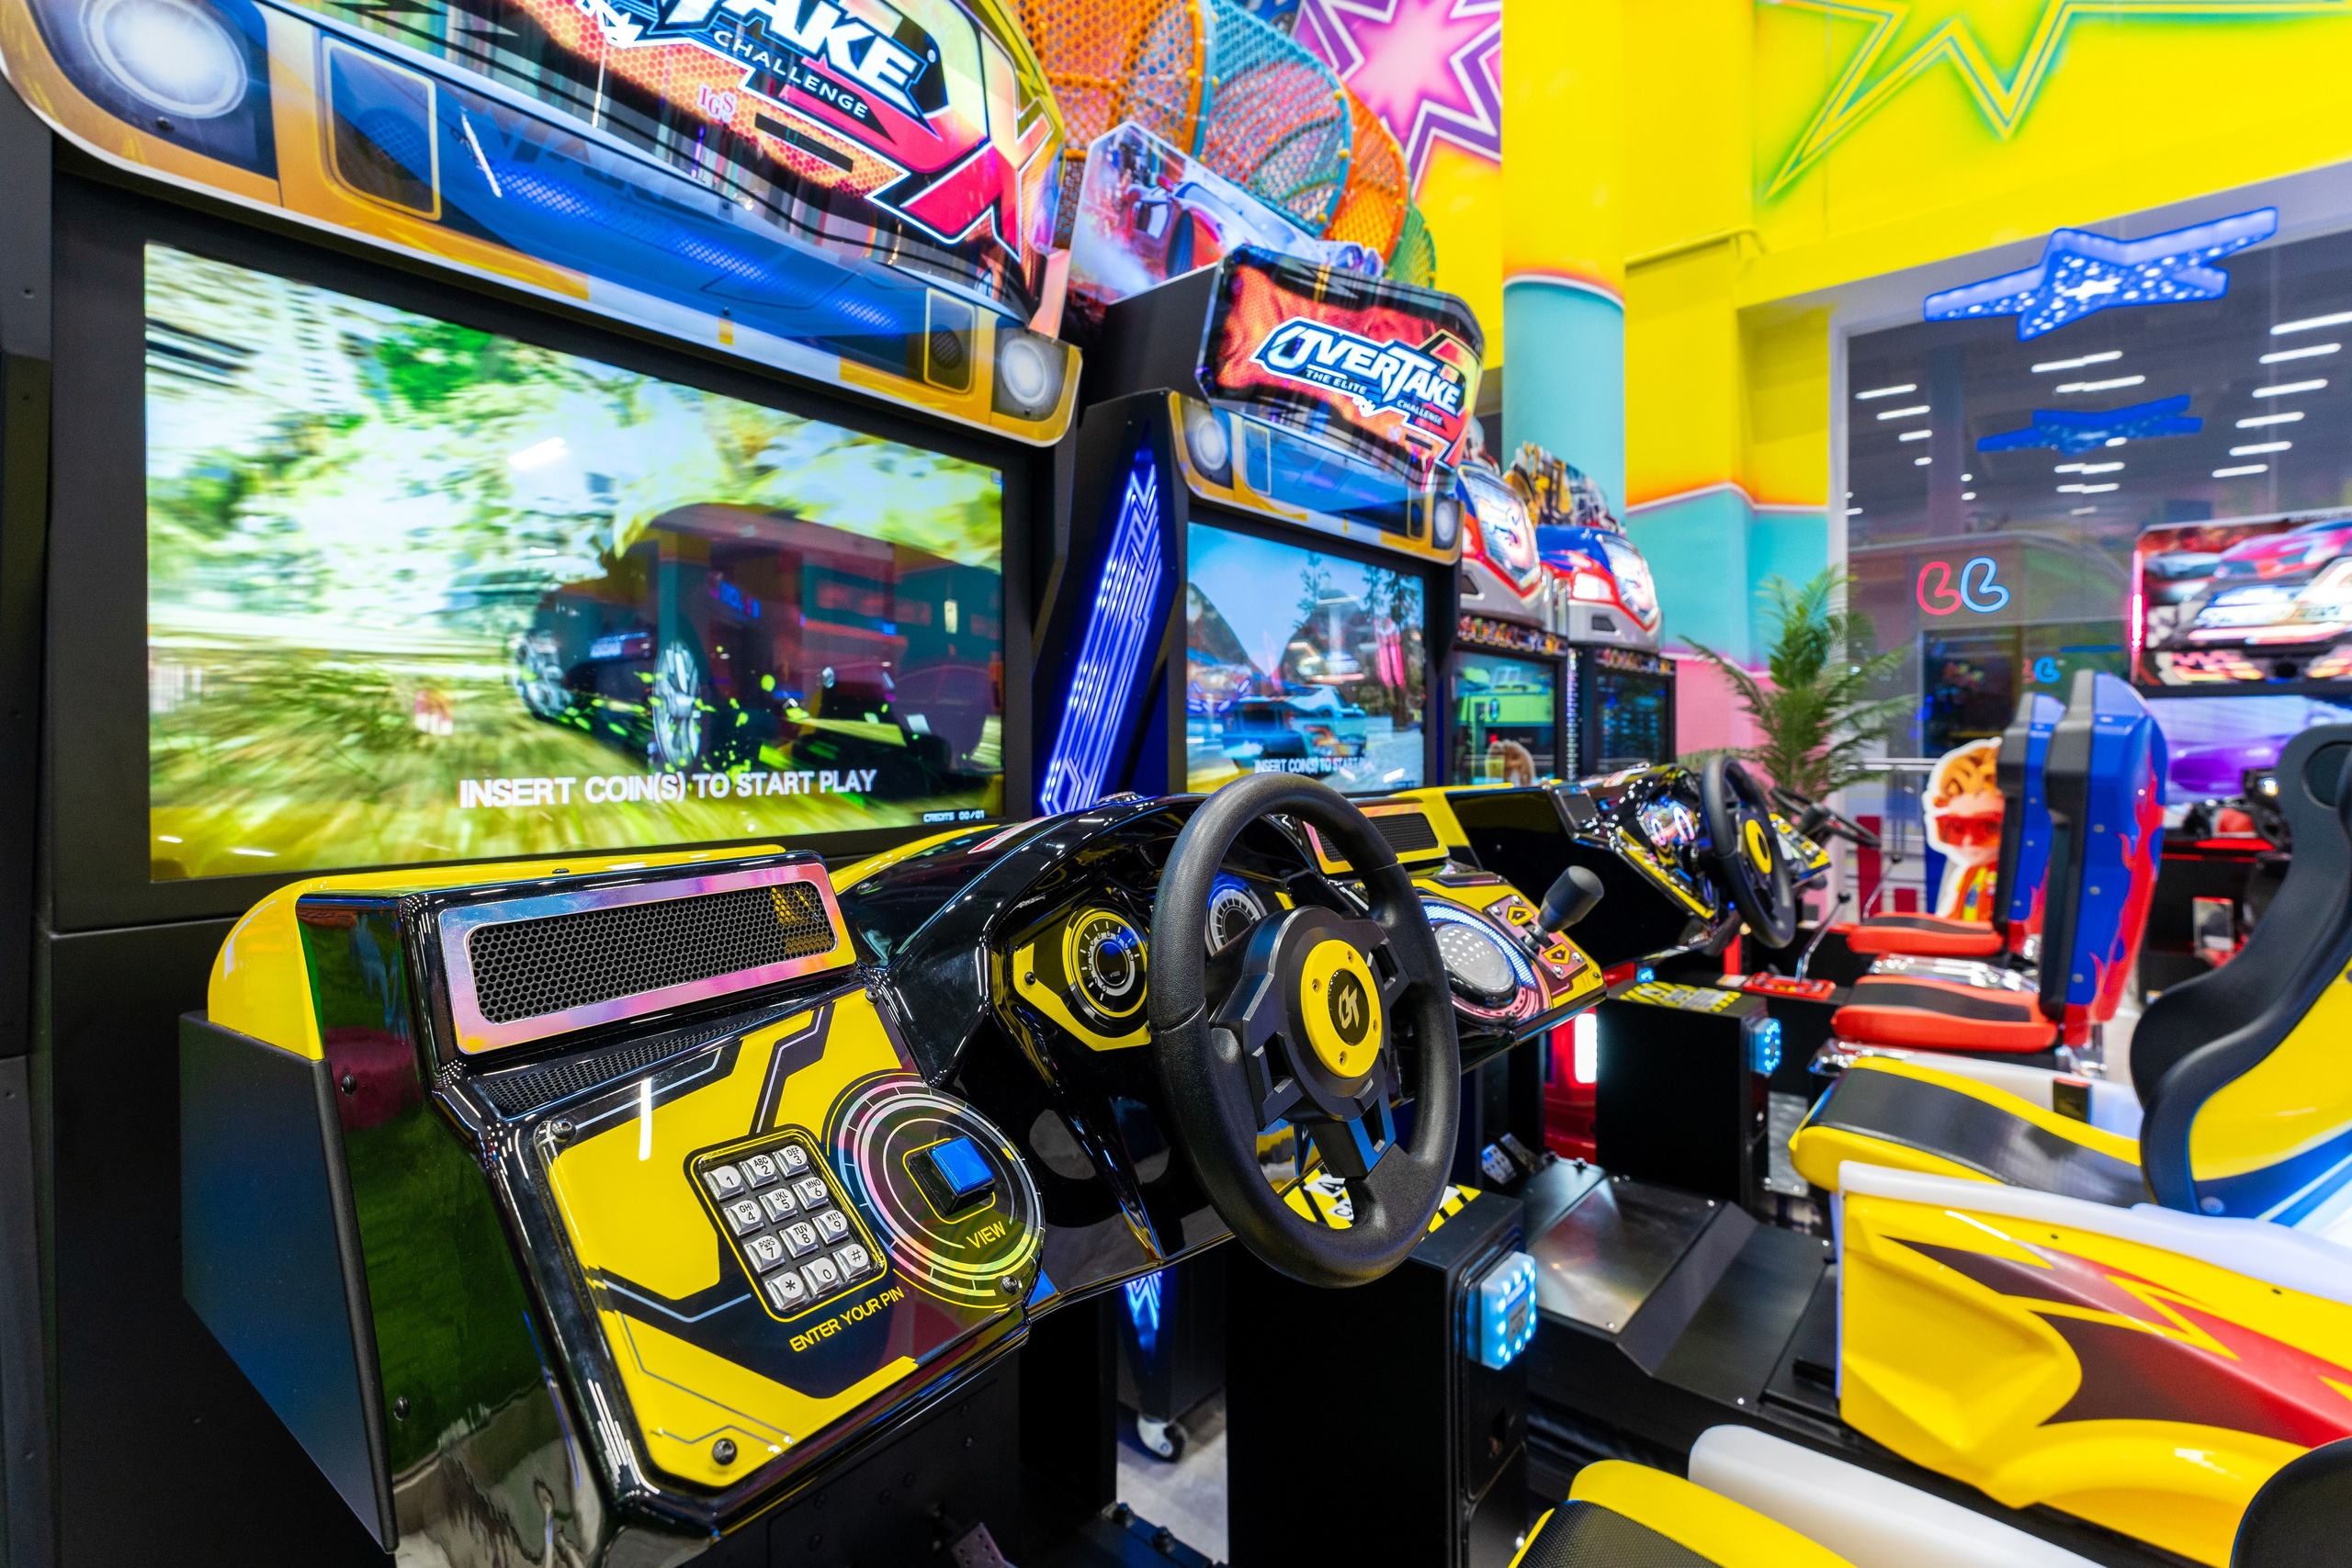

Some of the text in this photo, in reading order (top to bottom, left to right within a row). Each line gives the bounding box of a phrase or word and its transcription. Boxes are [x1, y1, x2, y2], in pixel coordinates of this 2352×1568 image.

[713, 30, 869, 119] CHALLENGE
[698, 85, 735, 117] IGS
[1267, 325, 1460, 417] OVERTAKE
[1306, 369, 1367, 395] THE ELITE
[1396, 399, 1444, 427] CHALLENGE
[459, 769, 877, 808] INSERT COIN(S) TO START PLAY
[786, 1147, 799, 1157] DEF
[753, 1156, 769, 1168] ABC
[794, 1155, 803, 1165] 3
[762, 1165, 771, 1175] 2
[726, 1176, 734, 1186] 1
[806, 1179, 821, 1190] MNO
[775, 1190, 788, 1201] JKL
[814, 1188, 822, 1197] 6
[739, 1202, 753, 1213] GHI
[781, 1199, 790, 1210] 5
[748, 1212, 756, 1221] 4
[825, 1211, 842, 1223] WXYZ
[793, 1224, 808, 1235] TUV
[833, 1220, 842, 1230] 9
[801, 1233, 810, 1244] 8
[966, 1221, 1006, 1248] VIEW
[758, 1237, 775, 1249] PQRS
[765, 1247, 775, 1258] 7
[822, 1269, 831, 1280] 0
[789, 1286, 904, 1352] ENTER YOUR PIN
